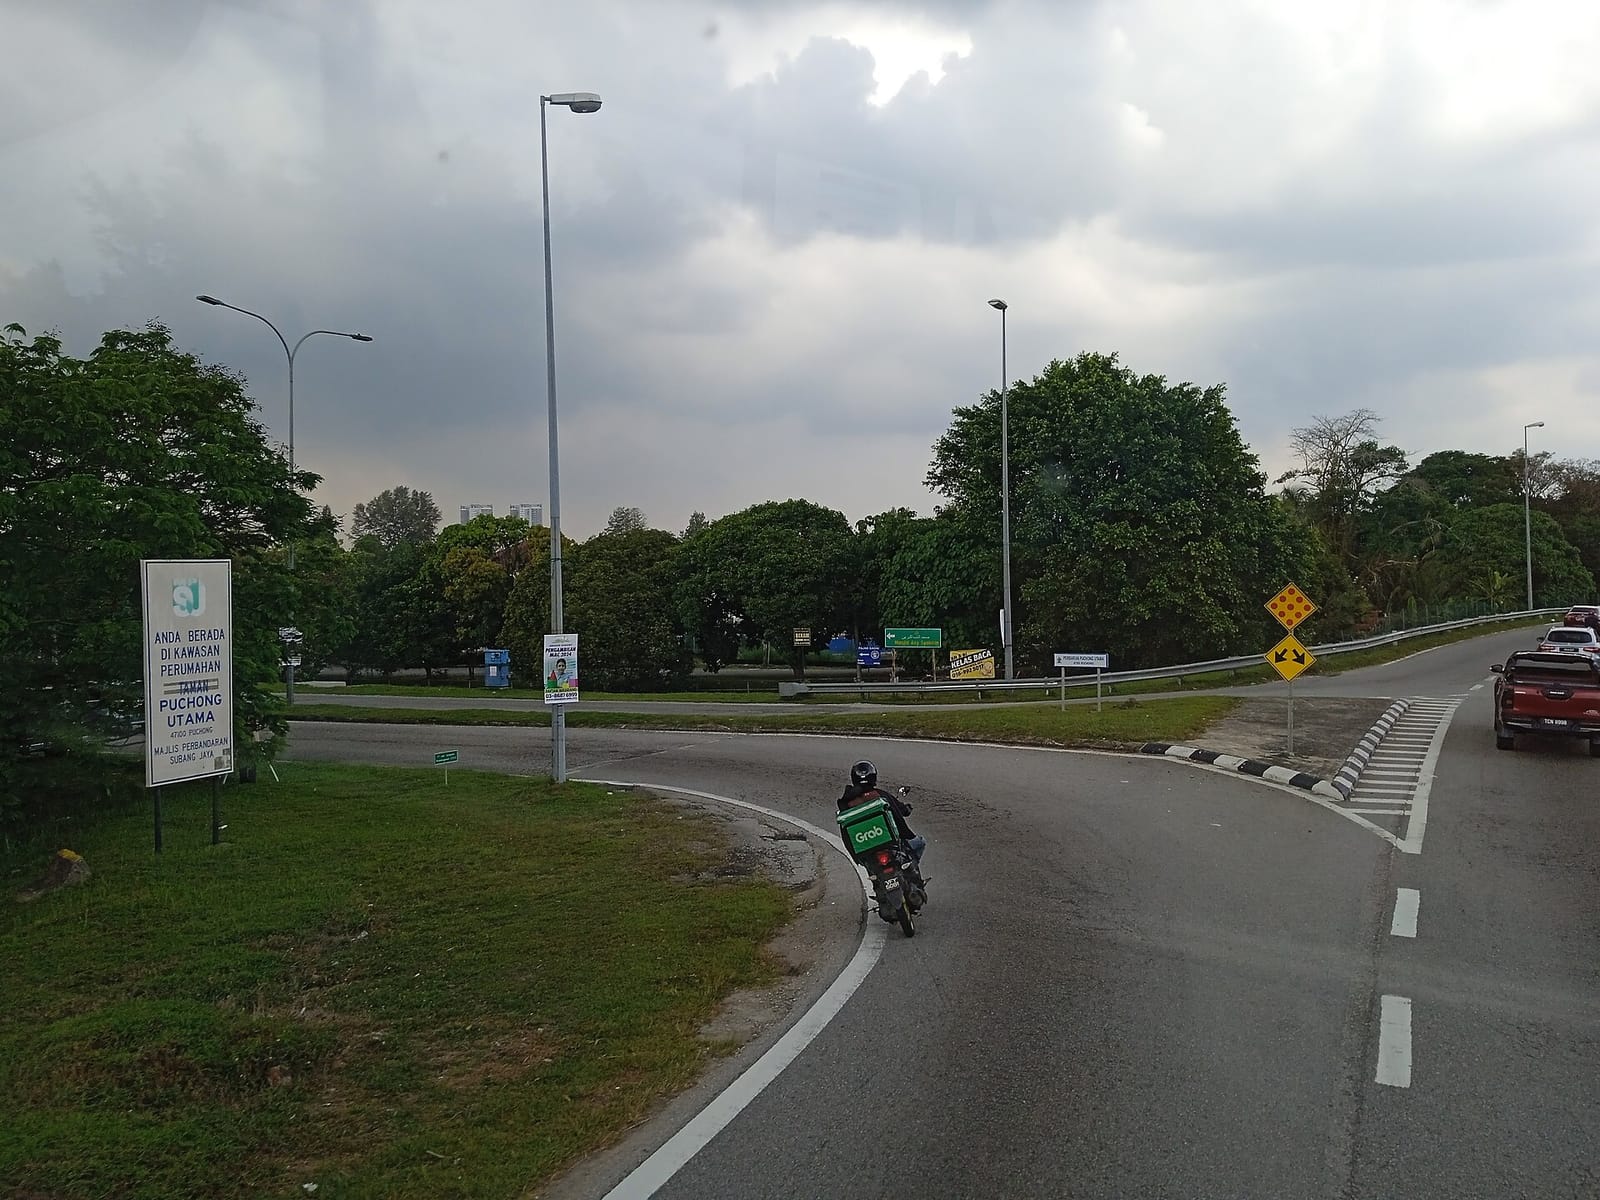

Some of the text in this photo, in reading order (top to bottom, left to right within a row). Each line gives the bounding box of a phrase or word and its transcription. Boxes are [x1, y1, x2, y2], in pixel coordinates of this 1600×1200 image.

[154, 629, 225, 644] ANDA BERADA
[161, 644, 220, 660] DI KAWASAN
[951, 655, 973, 669] KELAS
[973, 650, 992, 662] BACA
[161, 660, 221, 677] PERUMAHAN
[179, 679, 209, 694] TAMAN
[159, 693, 222, 712] PUCHONG
[167, 710, 215, 727] UTAMA
[170, 726, 213, 738] 47100 PUCHONG
[154, 736, 228, 755] MAJLIS PERBANDARAN
[170, 750, 214, 765] SUBANG JAYA
[855, 825, 883, 843] Grab
